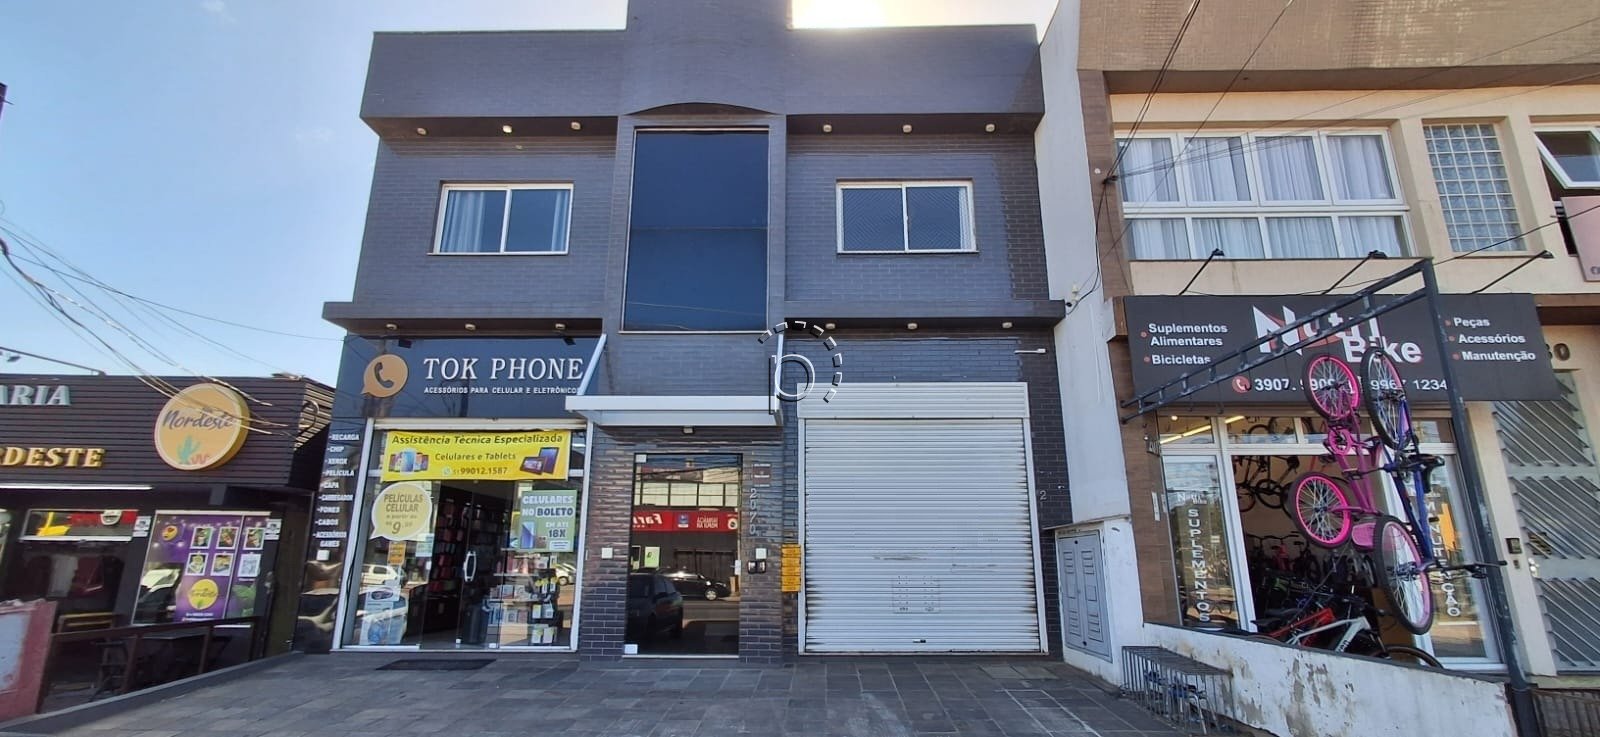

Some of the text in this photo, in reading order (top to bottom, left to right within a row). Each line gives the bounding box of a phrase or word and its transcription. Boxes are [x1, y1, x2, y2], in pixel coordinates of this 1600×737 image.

[1453, 317, 1490, 328] Peças
[1148, 323, 1228, 335] Suplementos
[1151, 336, 1223, 346] Alimentares
[1458, 334, 1526, 344] Acessórios
[1342, 334, 1423, 363] Bike
[1152, 354, 1212, 365] Bicicletas
[1462, 351, 1537, 362] Manutenção
[423, 358, 584, 380] TOK PHONE
[424, 385, 468, 394] ACESSÓRIOS
[1413, 379, 1448, 390] 1234
[162, 409, 234, 430] Nordeste
[392, 433, 563, 446] Assistência Técnica Especializada
[0, 446, 105, 468] DESTE
[435, 453, 475, 461] Celulares
[485, 453, 516, 461] Tablets
[523, 495, 574, 505] CELULARES
[386, 503, 419, 512] CELULAR
[537, 508, 573, 516] BOLETO
[749, 488, 757, 535] 2070
[1188, 508, 1211, 622] SUPLEMENTOS
